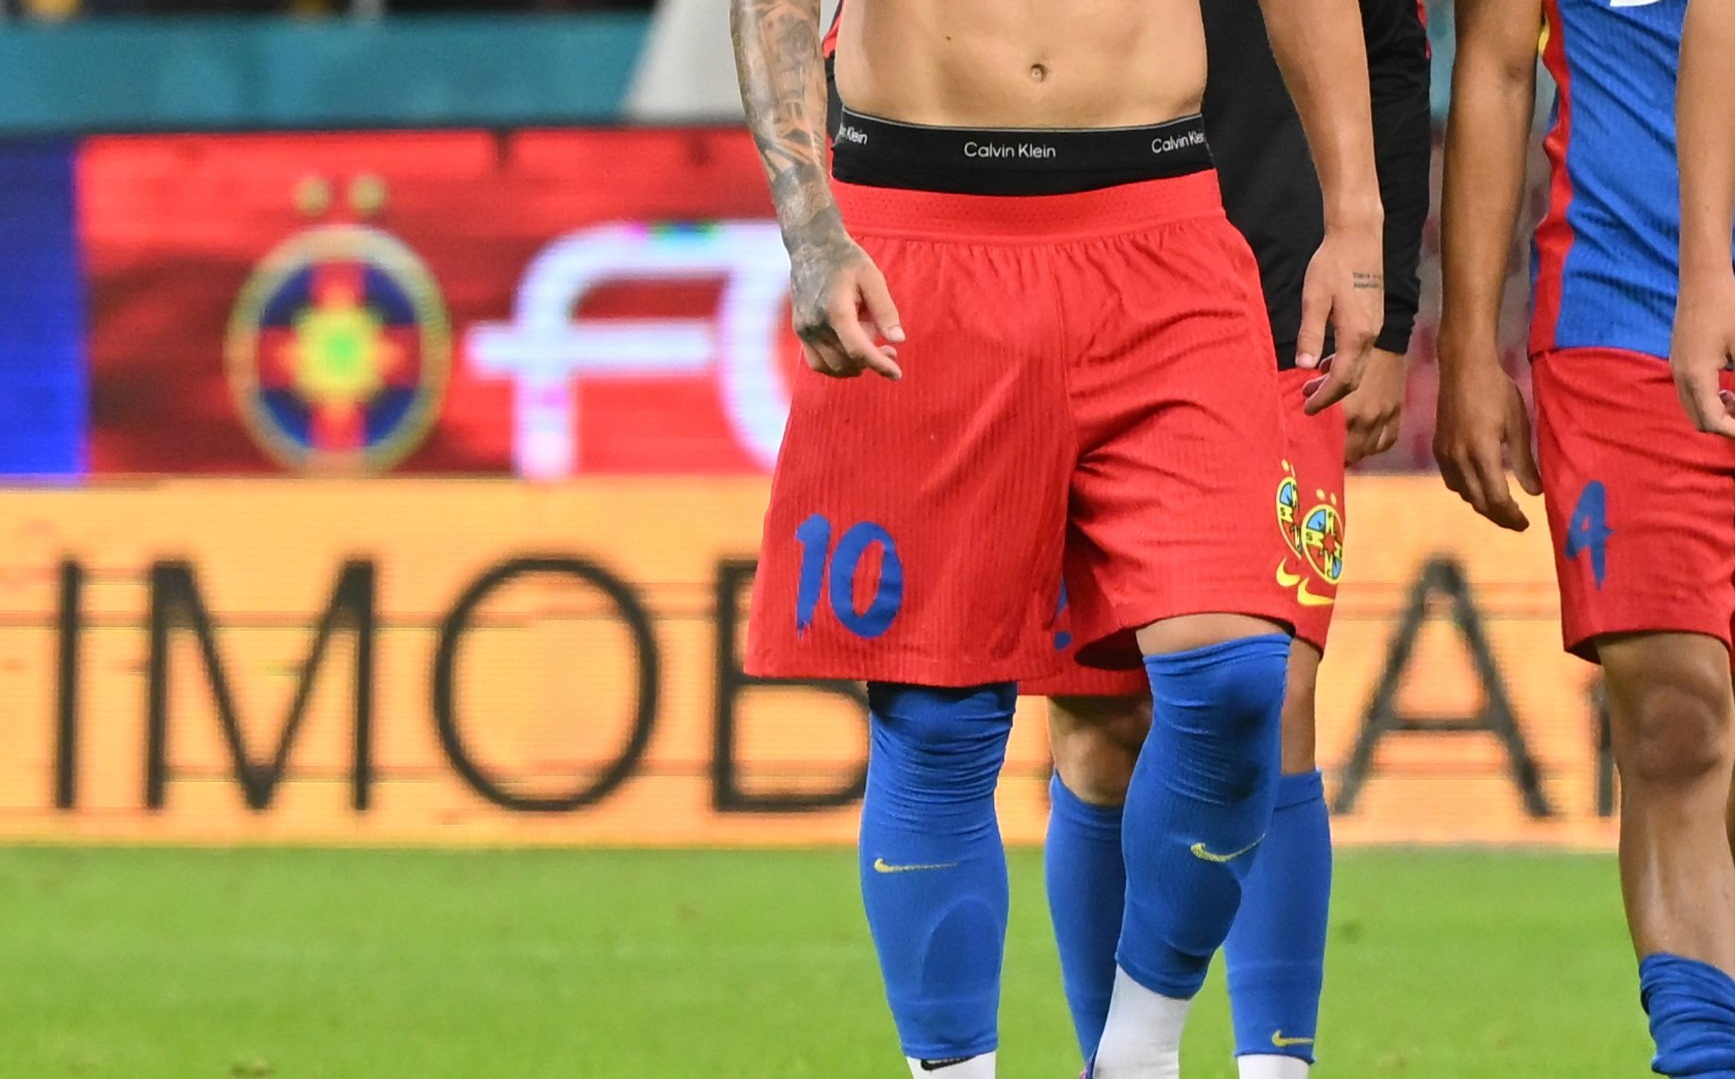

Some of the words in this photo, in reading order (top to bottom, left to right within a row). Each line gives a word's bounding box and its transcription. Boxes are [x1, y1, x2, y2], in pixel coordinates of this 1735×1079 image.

[963, 141, 1015, 158] Calvin
[1018, 143, 1056, 159] Klein
[1151, 134, 1189, 154] Calvin
[1564, 480, 1613, 590] 4
[795, 513, 904, 640] 10
